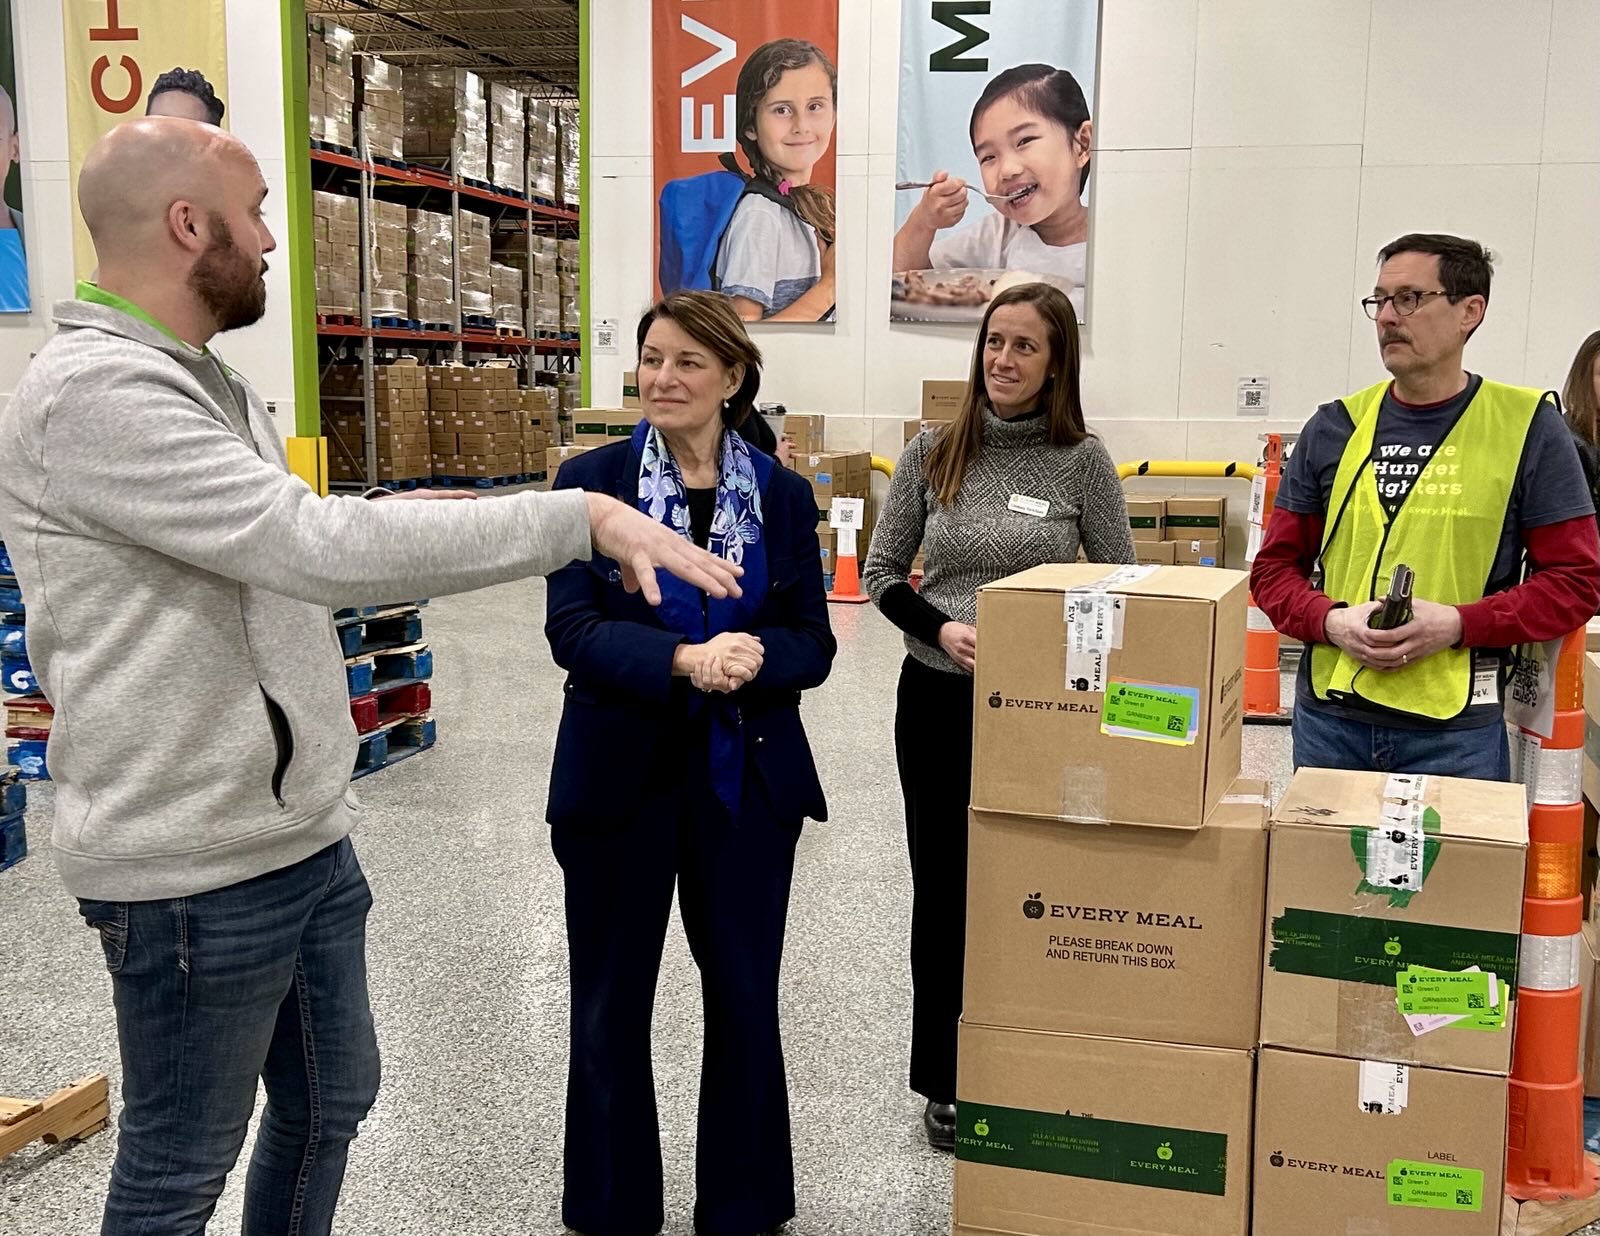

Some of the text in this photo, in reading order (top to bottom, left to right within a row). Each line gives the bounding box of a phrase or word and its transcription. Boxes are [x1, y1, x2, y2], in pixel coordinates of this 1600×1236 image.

[929, 1, 991, 72] M
[681, 0, 737, 153] EV
[1380, 444, 1411, 457] We
[1373, 461, 1460, 480] Hunger
[1374, 478, 1463, 498] ighters
[1005, 698, 1099, 714] EVERY MEAL
[1128, 690, 1178, 705] EVERY MEAL
[1411, 837, 1419, 870] EVERY
[1050, 904, 1203, 930] EVERY MEAL
[1049, 935, 1173, 956] PLEASE BREAK DOWN
[1046, 949, 1176, 970] AND RETURN THIS BOX
[1354, 955, 1394, 967] EVERY
[985, 1141, 1014, 1151] MEAL
[1427, 1151, 1457, 1162] LABEL
[1130, 1160, 1199, 1175] EVERY MEAL
[1287, 1158, 1385, 1180] EVERY MEAL
[1439, 1171, 1462, 1179] MEAL
